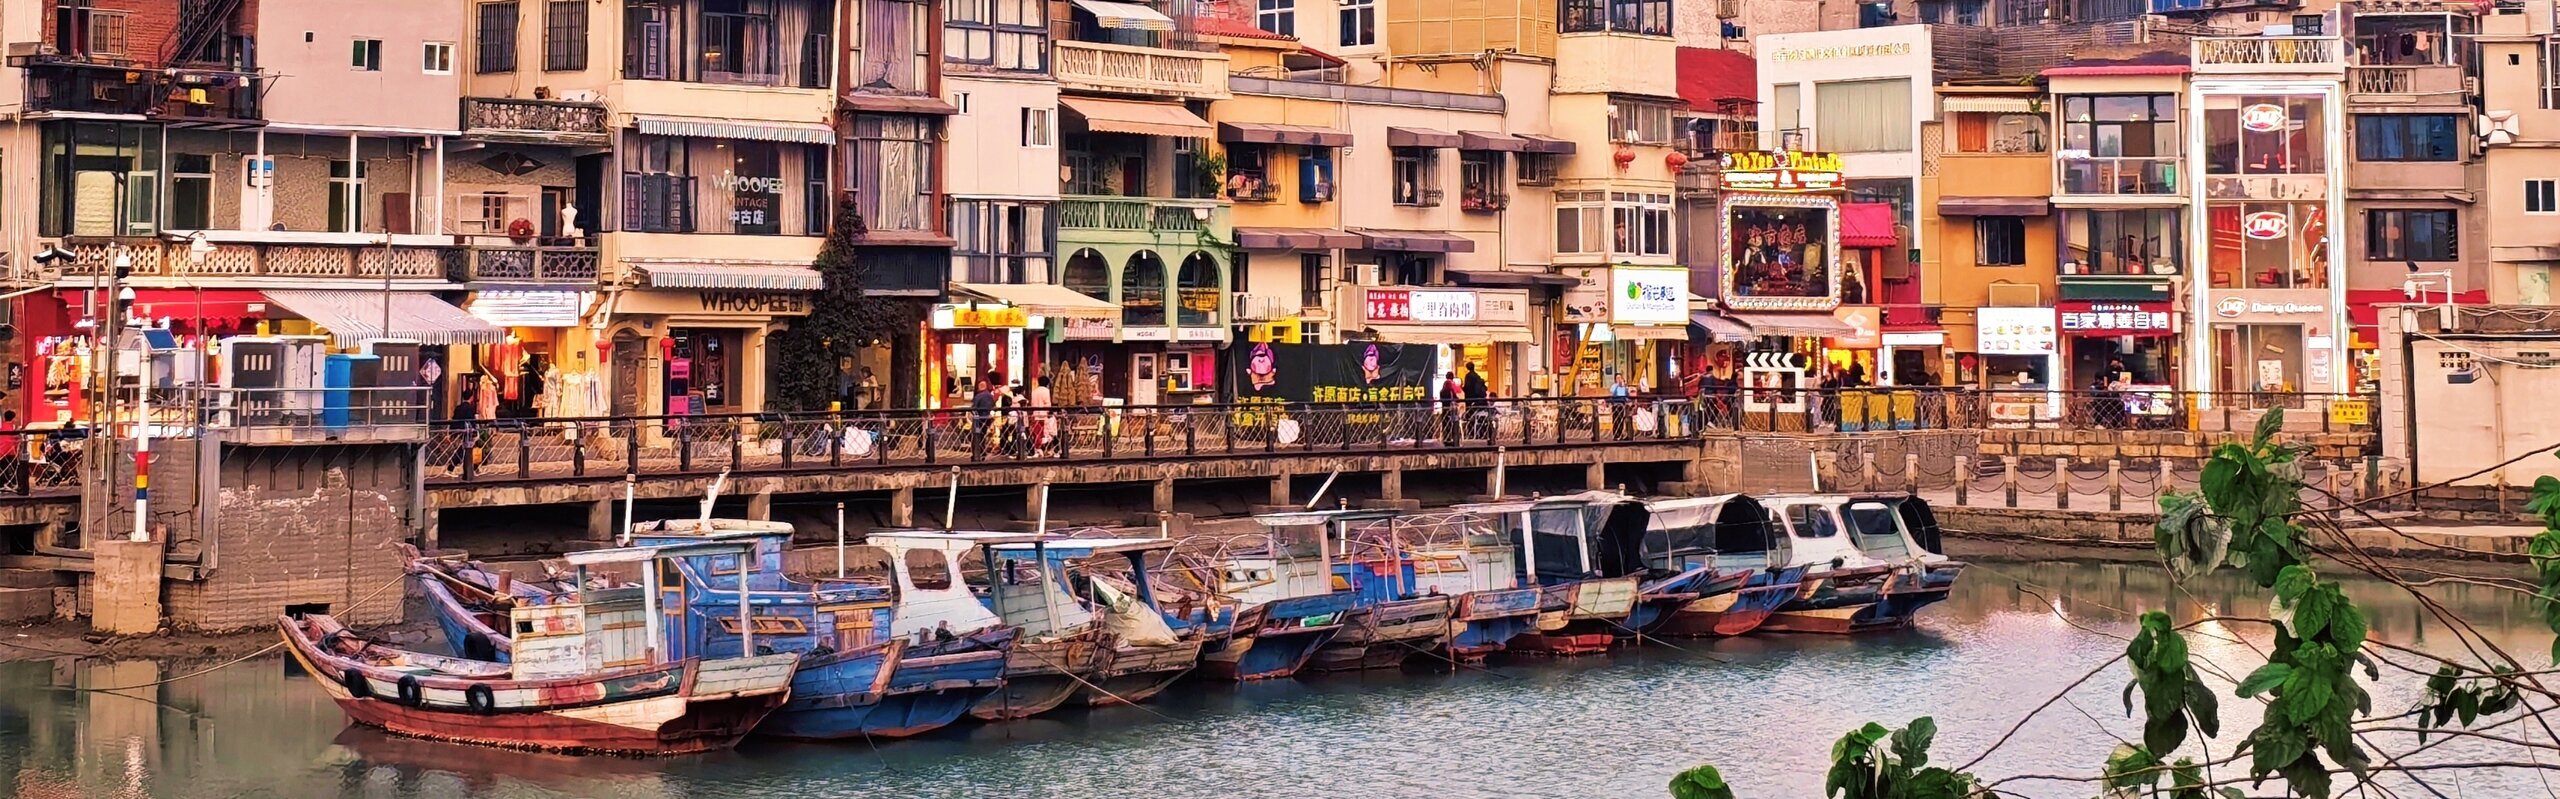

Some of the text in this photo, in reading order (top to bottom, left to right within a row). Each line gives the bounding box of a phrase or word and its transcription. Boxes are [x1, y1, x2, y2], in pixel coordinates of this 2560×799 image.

[1732, 152, 1774, 170] YeYee
[711, 174, 784, 194] WHOOPEE
[726, 194, 769, 208] VNTAGE
[729, 209, 765, 225] 中古店
[700, 291, 788, 312] WHOOPEE
[2251, 302, 2324, 315] Dairy Queen
